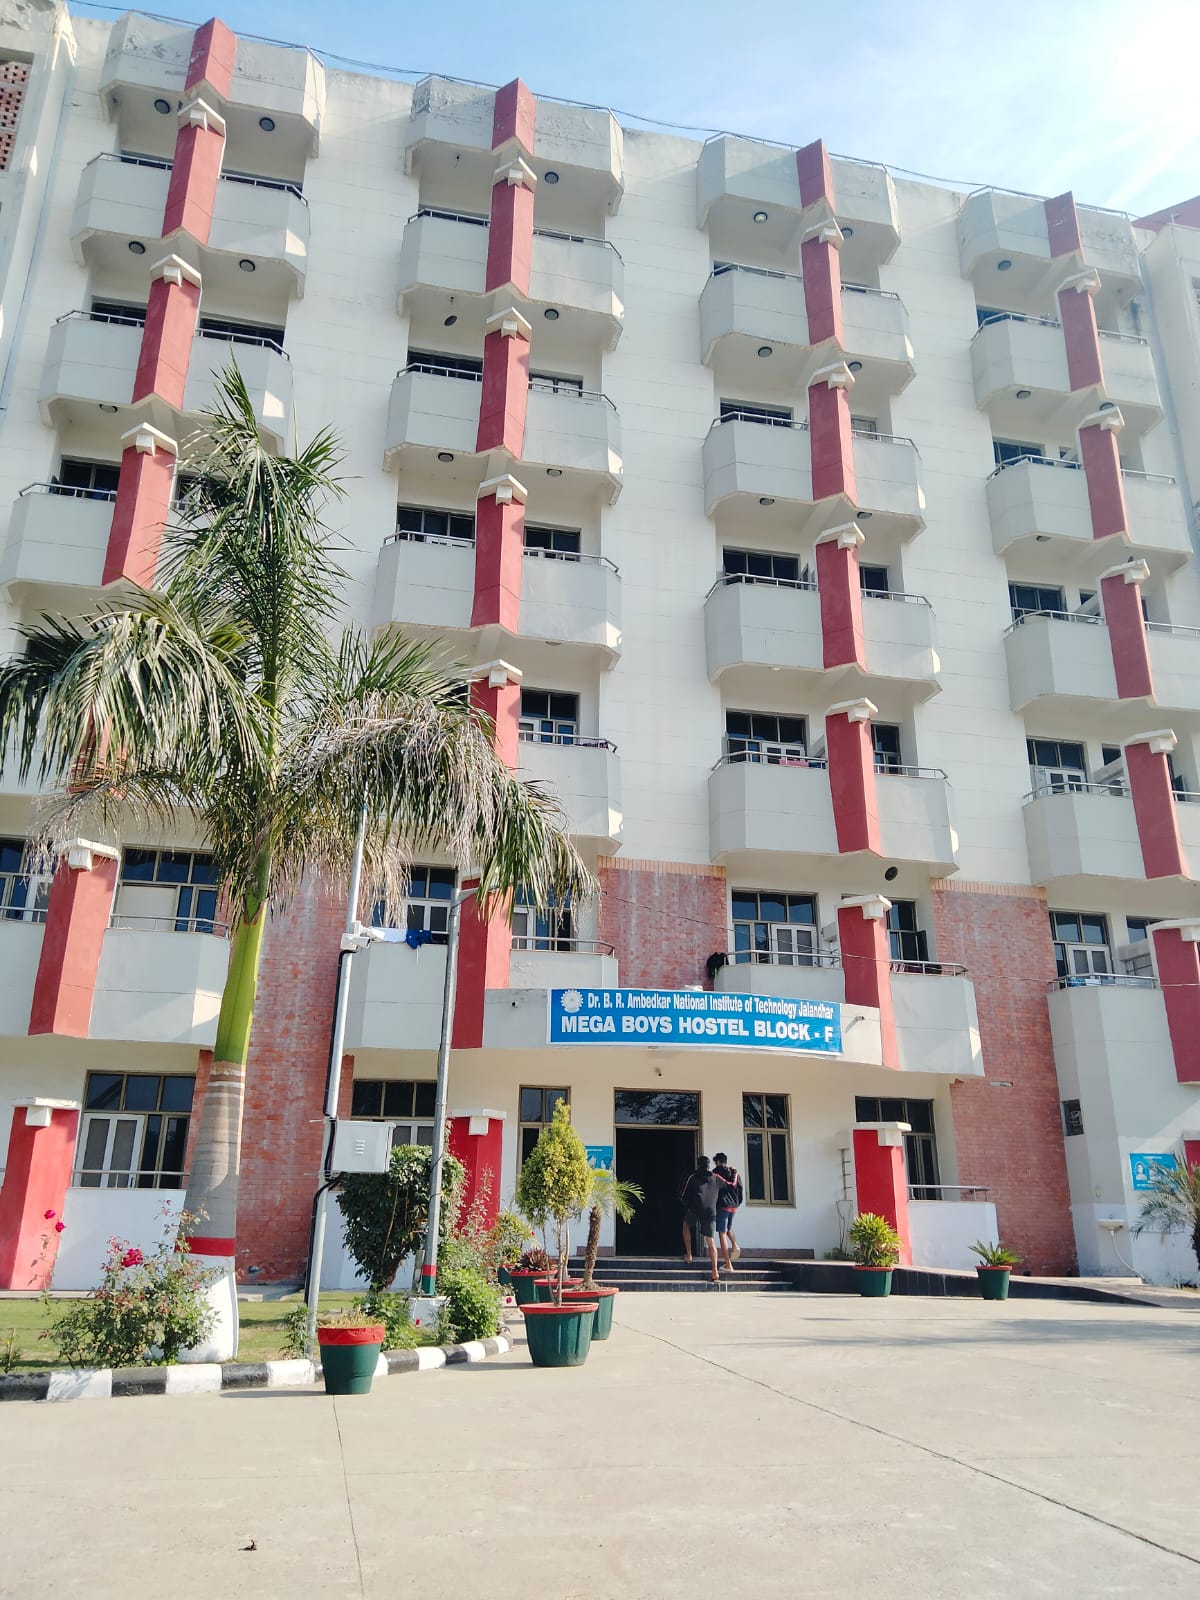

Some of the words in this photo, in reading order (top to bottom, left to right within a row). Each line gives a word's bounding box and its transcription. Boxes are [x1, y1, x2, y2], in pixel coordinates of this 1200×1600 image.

[588, 992, 601, 1009] Dr.
[604, 992, 613, 1009] B.
[616, 992, 625, 1009] R.
[627, 993, 671, 1009] Ambedkar
[674, 994, 708, 1011] National
[710, 996, 743, 1012] Institute
[744, 997, 753, 1013] of
[755, 998, 797, 1019] Technology
[798, 1002, 834, 1020] Jalandhar
[562, 1016, 616, 1033] MEGA
[622, 1016, 673, 1034] BOYS
[678, 1017, 749, 1036] HOSTEL
[754, 1020, 811, 1041] BLOCK
[824, 1026, 834, 1043] F
